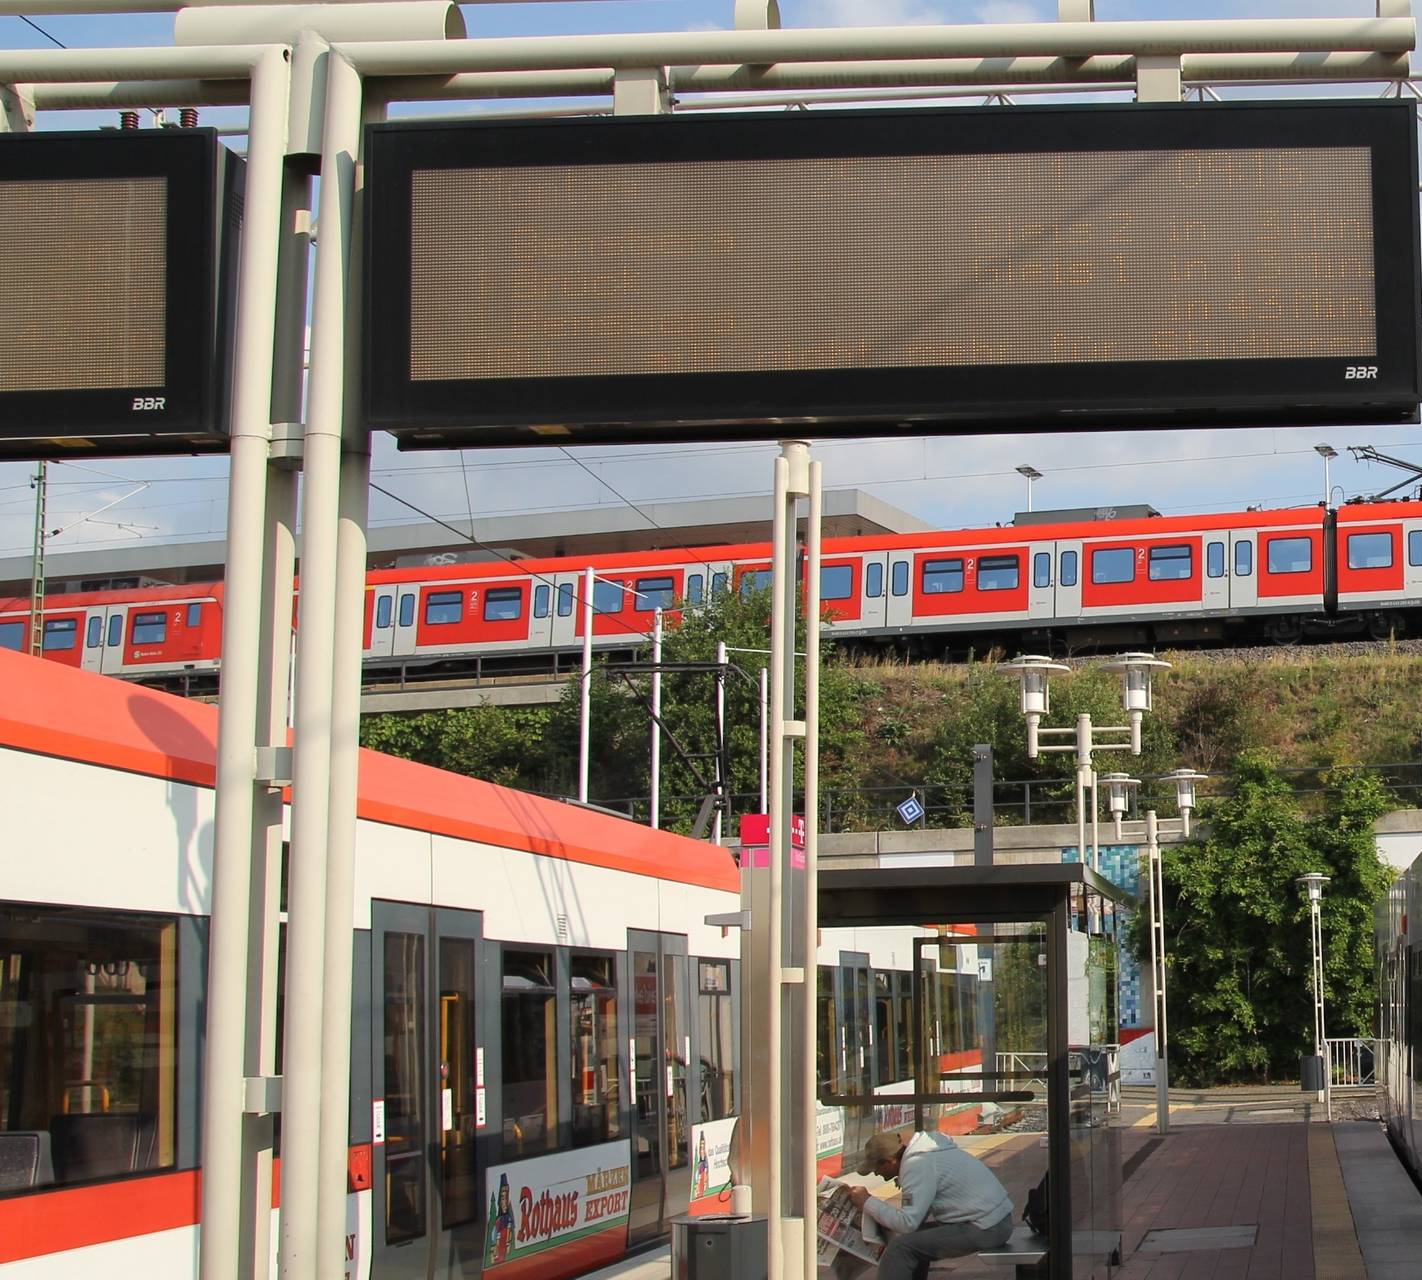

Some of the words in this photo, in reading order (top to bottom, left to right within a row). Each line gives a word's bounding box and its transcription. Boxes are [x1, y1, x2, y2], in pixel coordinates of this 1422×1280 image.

[1168, 213, 1208, 241] in
[1169, 253, 1208, 281] in
[1170, 293, 1210, 320] in
[1345, 366, 1379, 380] BBR
[132, 397, 166, 410] BBR
[1138, 548, 1145, 560] 2
[967, 558, 974, 570] 2
[626, 580, 633, 591] 2
[471, 591, 478, 601] 2
[175, 612, 181, 622] 2
[585, 1191, 628, 1222] EXPORT
[517, 1186, 579, 1242] Rothaus
